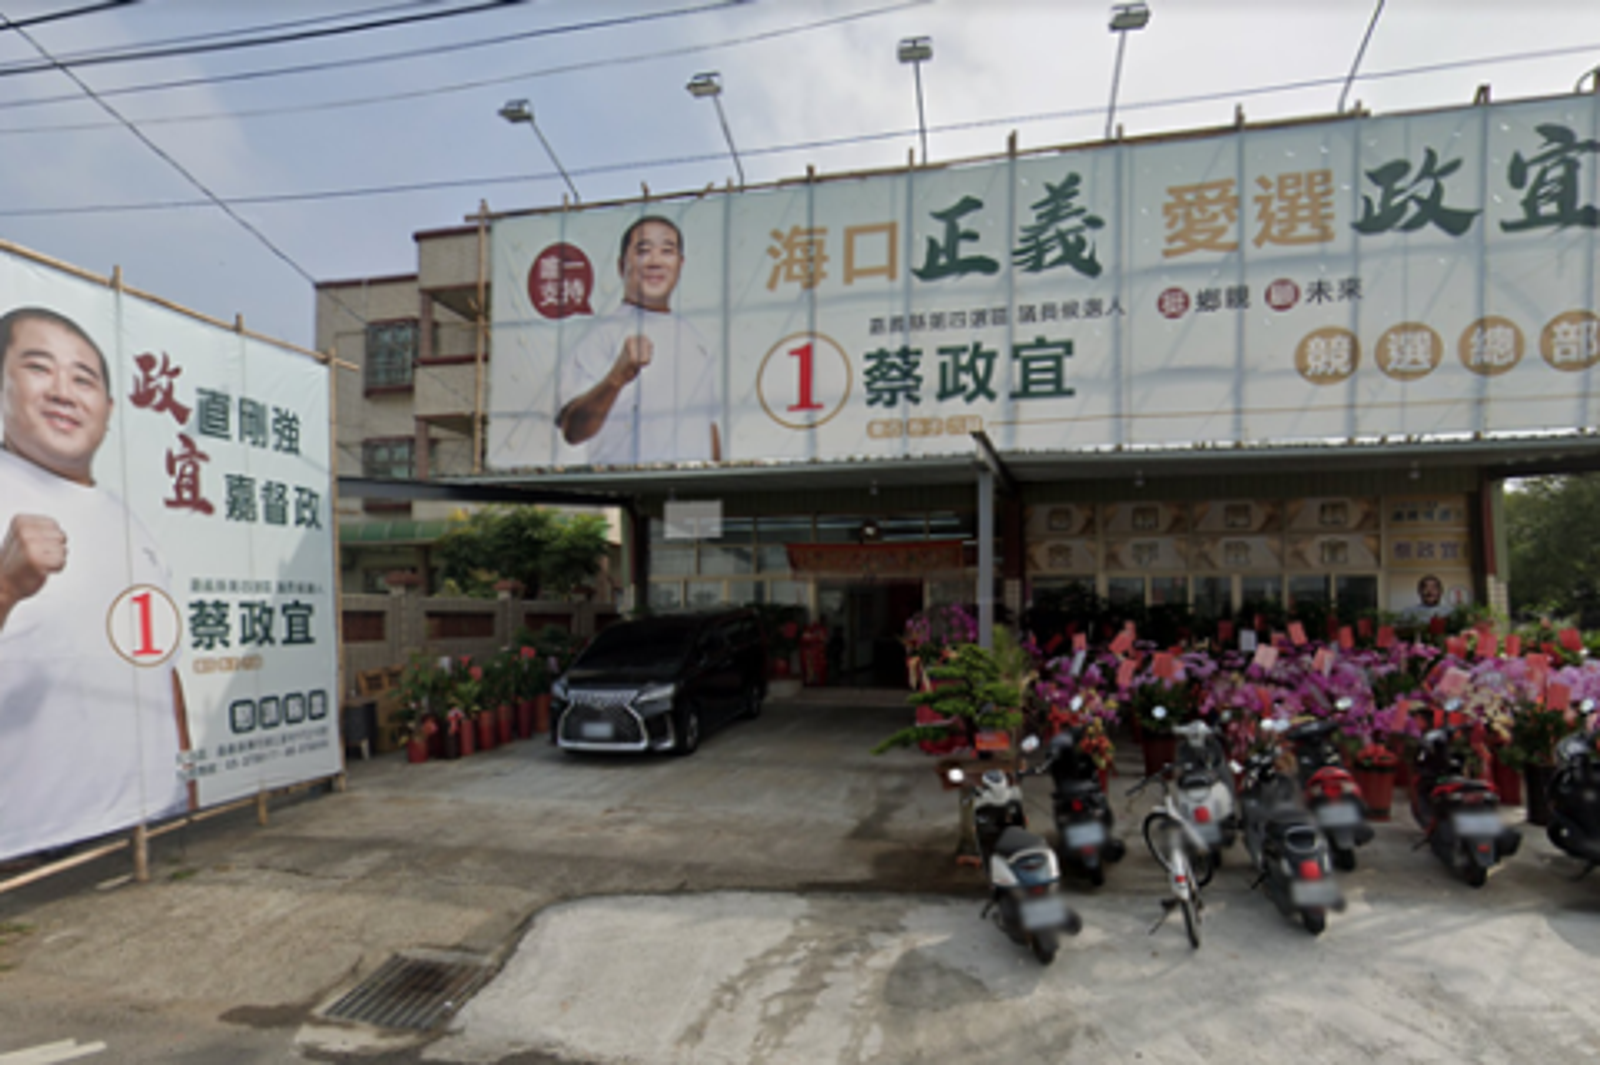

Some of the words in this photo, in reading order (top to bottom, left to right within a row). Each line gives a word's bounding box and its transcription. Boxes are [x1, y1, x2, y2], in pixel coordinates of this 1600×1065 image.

[766, 172, 1105, 292] 海口正義
[1161, 123, 1600, 258] 愛選政宜
[787, 342, 824, 412] 1
[863, 336, 1076, 408] 蔡政宜
[1305, 317, 1600, 377] 競選總部
[189, 599, 316, 650] 蔡政宜
